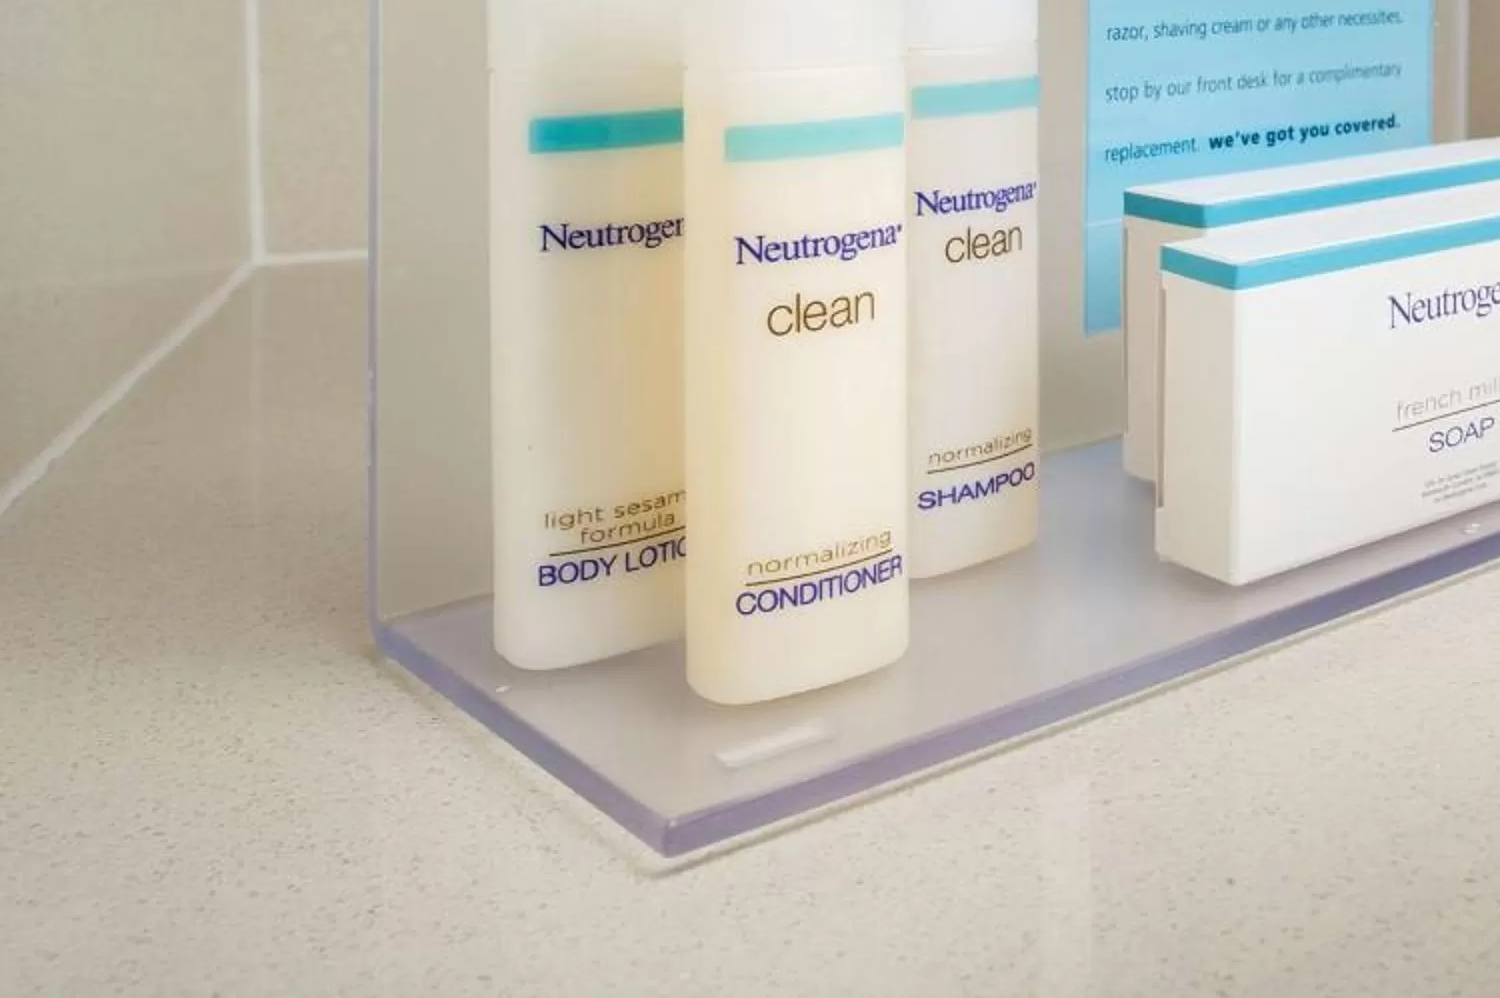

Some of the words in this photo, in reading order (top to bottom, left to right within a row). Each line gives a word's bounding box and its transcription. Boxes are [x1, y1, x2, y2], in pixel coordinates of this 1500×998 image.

[1106, 24, 1149, 42] razor,
[1153, 19, 1207, 40] shaving
[1211, 19, 1253, 36] cream
[1256, 17, 1270, 32] or
[1273, 16, 1298, 35] any
[1301, 11, 1335, 30] other
[1105, 84, 1140, 104] stop
[1143, 79, 1162, 101] by
[1166, 81, 1193, 97] our
[1196, 75, 1234, 94] front
[1237, 71, 1267, 92] desk
[1272, 68, 1293, 87] for
[1296, 71, 1305, 85] a
[1308, 60, 1402, 85] complimentary
[1104, 137, 1200, 165] replacement.
[1265, 125, 1296, 147] got
[1299, 122, 1331, 145] you
[1334, 111, 1401, 136] covered.
[945, 225, 1023, 263] clean
[767, 291, 876, 337] clean
[1396, 388, 1463, 423] french
[928, 427, 1033, 466] normalizing
[1428, 416, 1496, 454] SOAP
[917, 461, 1036, 510] SHAMPOO
[544, 506, 605, 532] light
[613, 489, 687, 519] sesam
[581, 512, 676, 544] formula
[538, 553, 619, 587] BODY
[747, 529, 892, 576] normalizing
[735, 554, 903, 616] CONDITIONER
